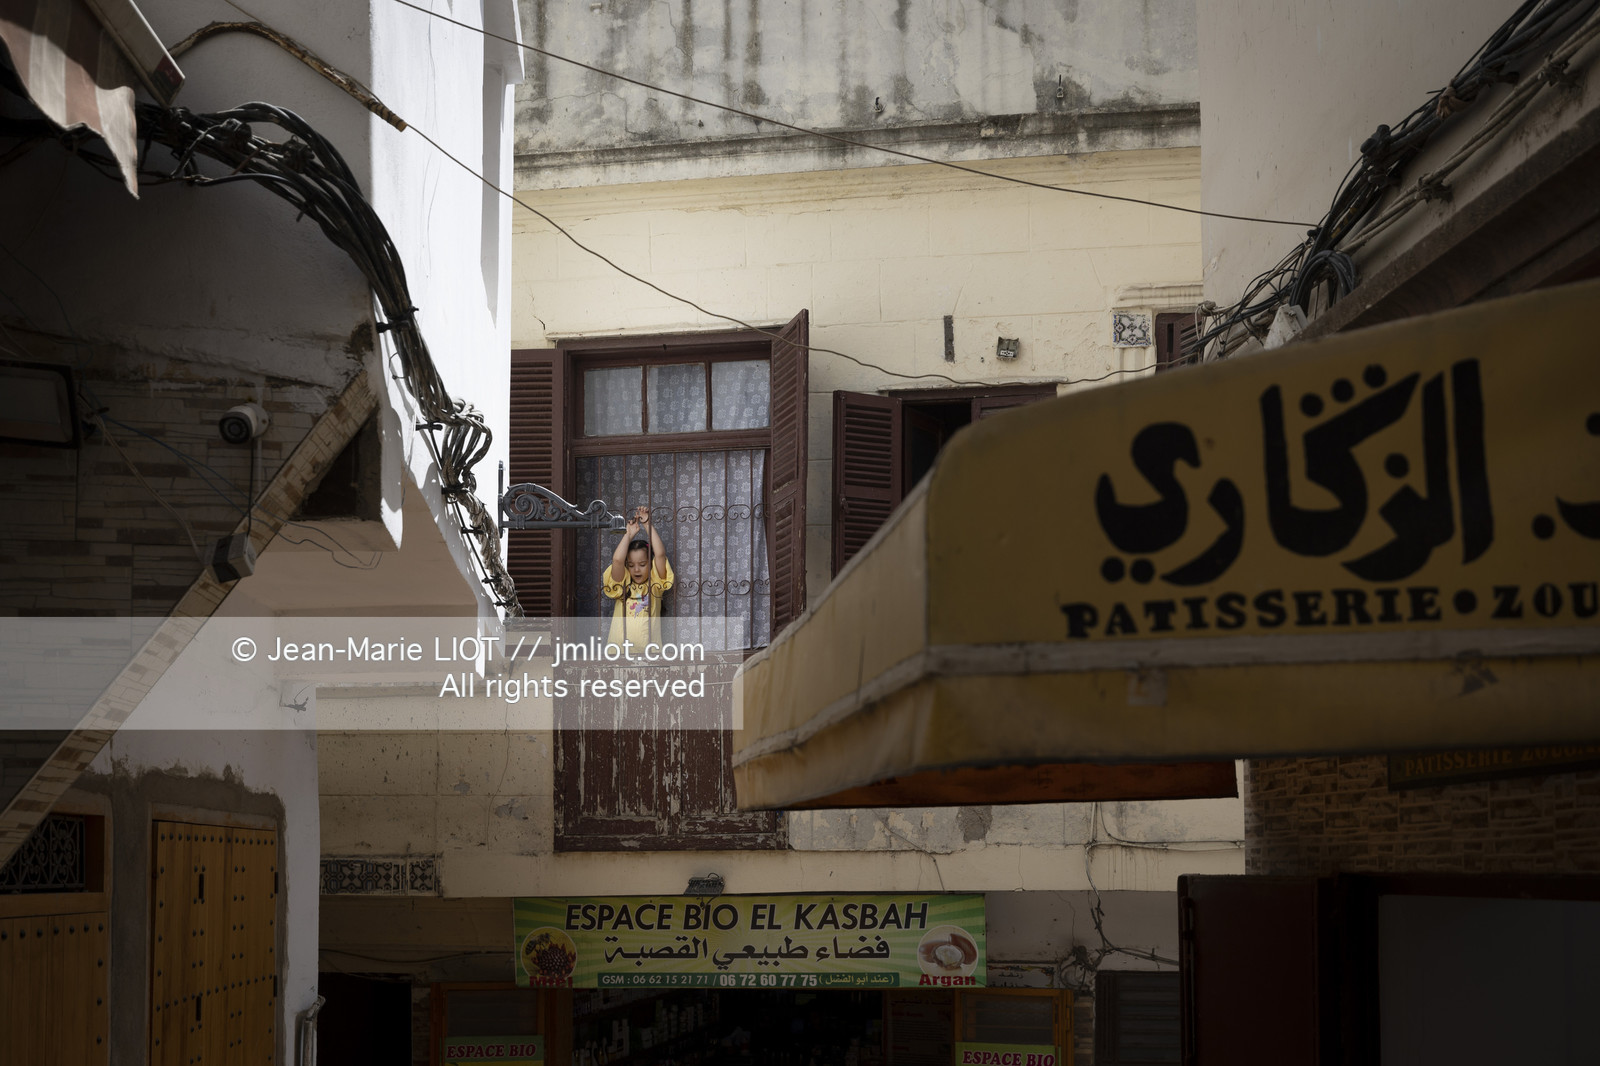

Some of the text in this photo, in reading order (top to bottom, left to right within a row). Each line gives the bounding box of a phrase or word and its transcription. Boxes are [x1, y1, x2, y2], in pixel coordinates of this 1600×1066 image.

[1061, 587, 1441, 638] PATISSERIE
[565, 903, 929, 930] ESPACE BIO EL KASBAH
[604, 935, 890, 970] فضاء طبيعي القصبة
[602, 975, 625, 985] GSM
[632, 975, 646, 985] 06
[649, 975, 662, 985] 62
[665, 975, 677, 985] 15
[681, 975, 692, 985] 21
[696, 975, 708, 985] 71
[719, 974, 736, 987] 06
[739, 974, 757, 987] 72
[760, 974, 777, 987] 60
[780, 974, 797, 987] 77
[800, 974, 817, 987] 75
[919, 973, 976, 987] Argan
[446, 1044, 536, 1058] ESPACE BIO
[962, 1051, 1022, 1066] ESPACE
[1025, 1053, 1055, 1066] BIO
